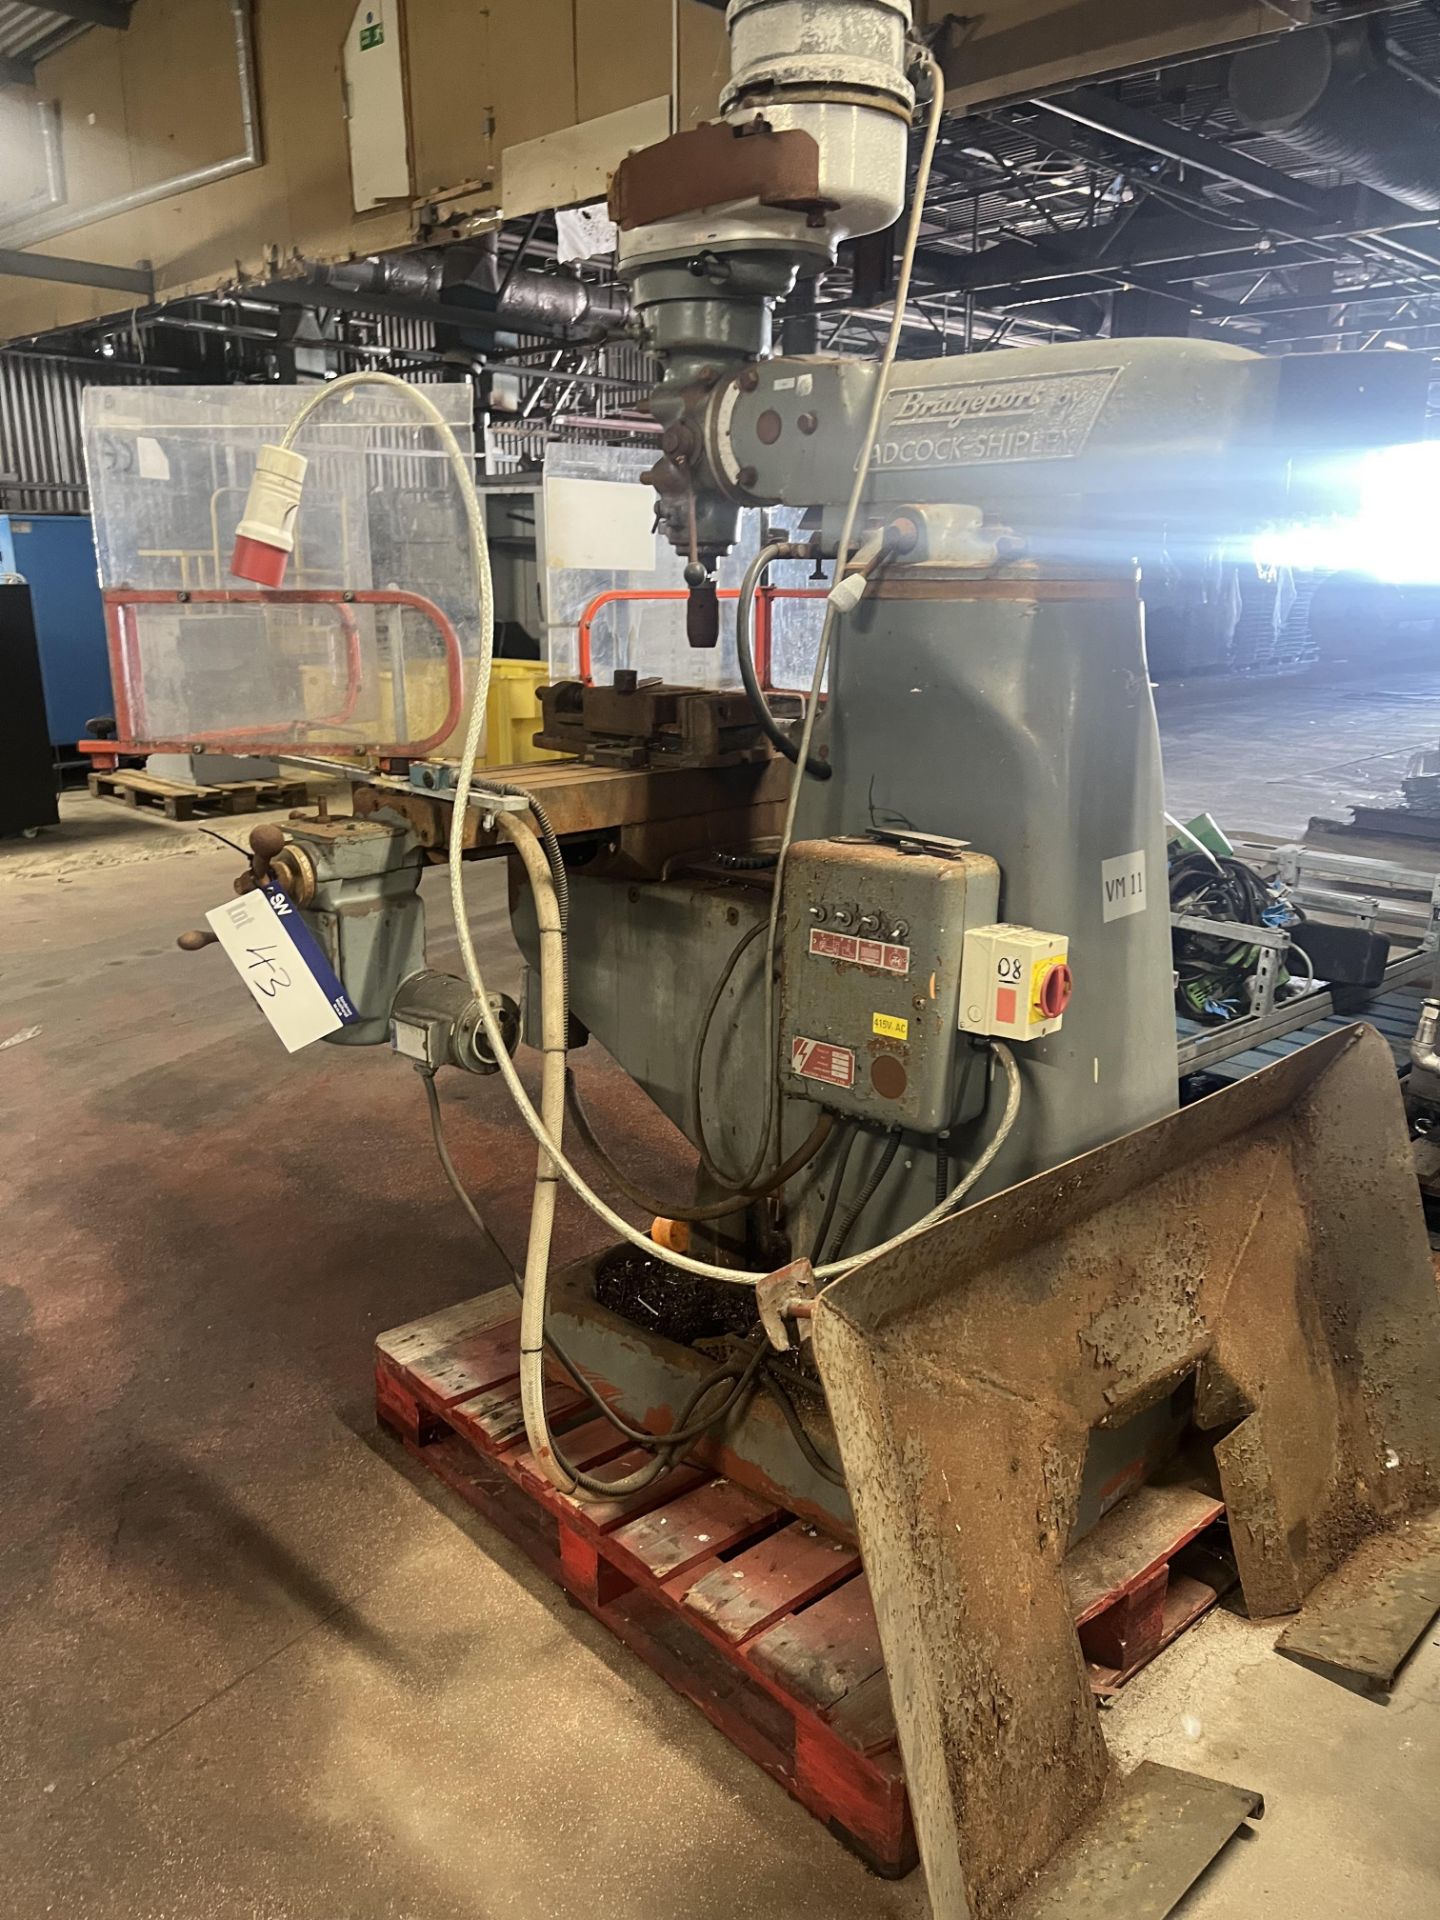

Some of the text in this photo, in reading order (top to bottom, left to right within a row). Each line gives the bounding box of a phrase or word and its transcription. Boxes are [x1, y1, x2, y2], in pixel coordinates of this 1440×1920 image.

[892, 386, 1045, 428] Bridgeport
[270, 893, 293, 916] SW
[1105, 872, 1143, 903] VM 11
[246, 945, 291, 997] 43
